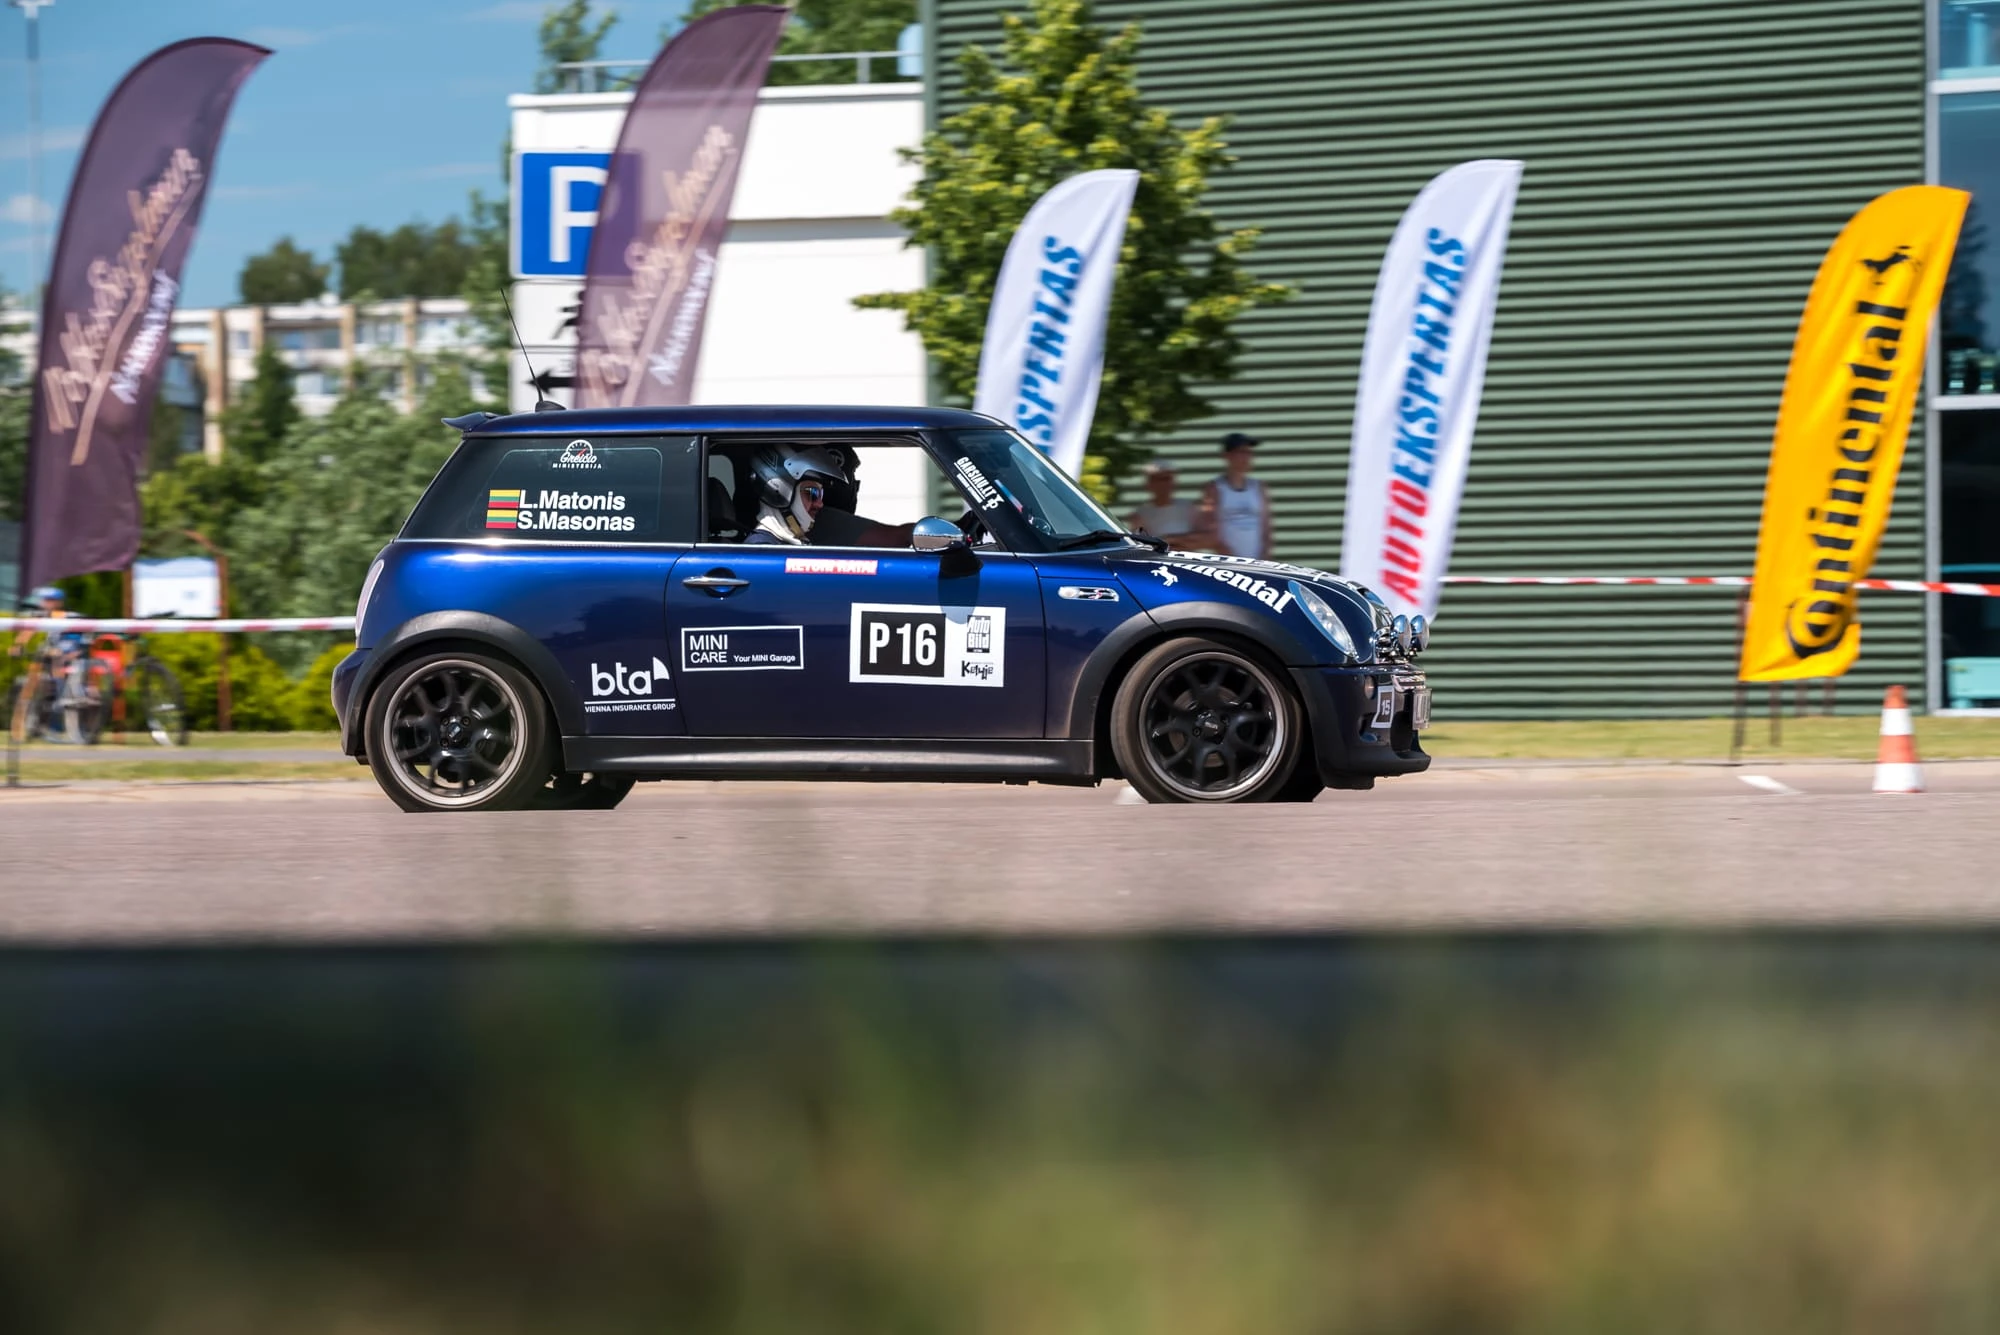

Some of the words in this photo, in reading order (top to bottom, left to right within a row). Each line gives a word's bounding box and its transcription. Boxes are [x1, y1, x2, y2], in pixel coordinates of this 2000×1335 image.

[550, 166, 620, 263] P
[956, 456, 998, 498] GARSIAU.LT
[519, 489, 626, 511] L.Matonis
[517, 510, 636, 532] S.Masonas
[689, 634, 728, 650] MINI
[690, 651, 727, 664] CARE
[733, 655, 751, 663] Your
[751, 654, 769, 662] MINI
[769, 653, 796, 663] Garage
[591, 662, 652, 696] bta
[585, 704, 611, 713] VIENNA
[612, 703, 651, 712] INSURANCE
[652, 702, 676, 711] GROUP
